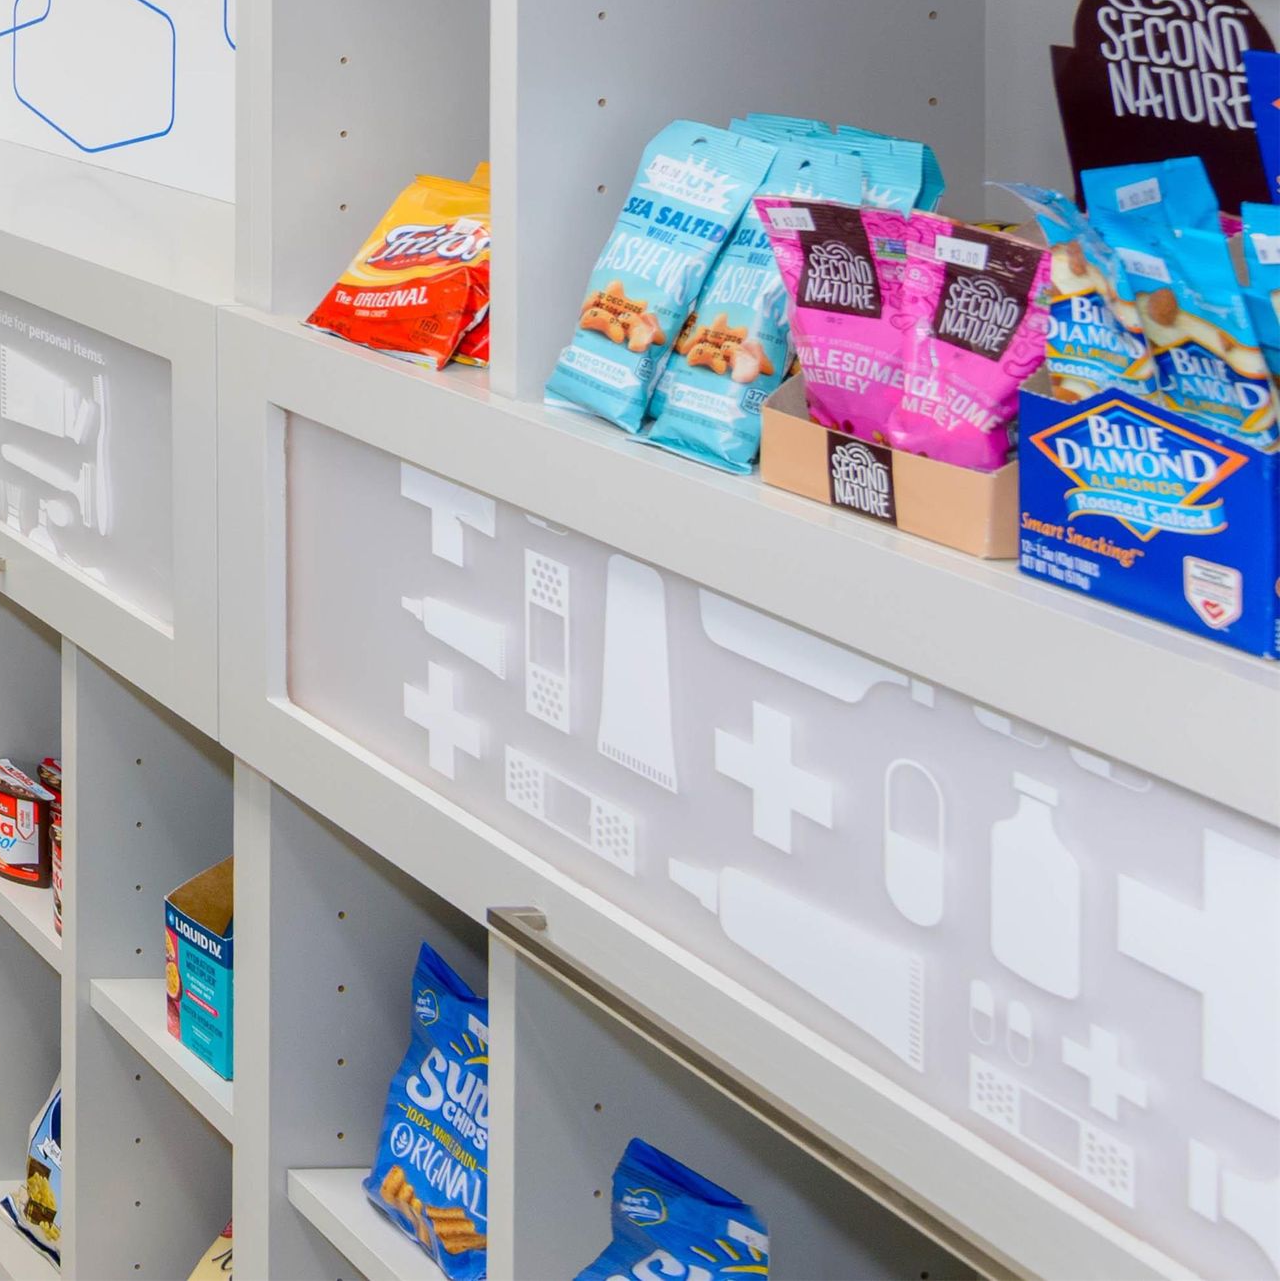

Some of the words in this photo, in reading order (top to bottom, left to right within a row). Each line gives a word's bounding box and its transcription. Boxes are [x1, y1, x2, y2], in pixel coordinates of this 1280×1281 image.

[1096, 4, 1250, 73] SECOND
[1107, 59, 1257, 131] NATURE
[656, 180, 714, 204] HARVEST
[623, 196, 654, 220] SEA
[655, 206, 728, 243] SALTED
[646, 225, 677, 245] WHOLE
[593, 232, 707, 306] ASHEWS
[807, 252, 874, 285] SECOND
[353, 286, 429, 307] ORIGINAL
[805, 278, 876, 310] NATURE
[944, 281, 1020, 330] SECOND
[938, 308, 1012, 354] NATURE
[802, 367, 873, 396] MEDLEY
[1169, 348, 1229, 381] BLUE
[1088, 414, 1169, 454] BLUE
[831, 455, 890, 494] SECOND
[1054, 437, 1218, 483] DIAMOND
[833, 483, 892, 519] NATURE
[1090, 474, 1186, 497] ALMONDS
[1021, 511, 1064, 540] Smart
[175, 916, 208, 950] LIQUID
[405, 1105, 431, 1131] 100%
[452, 1141, 477, 1171] GRAIN
[442, 1100, 488, 1151] CHIPS
